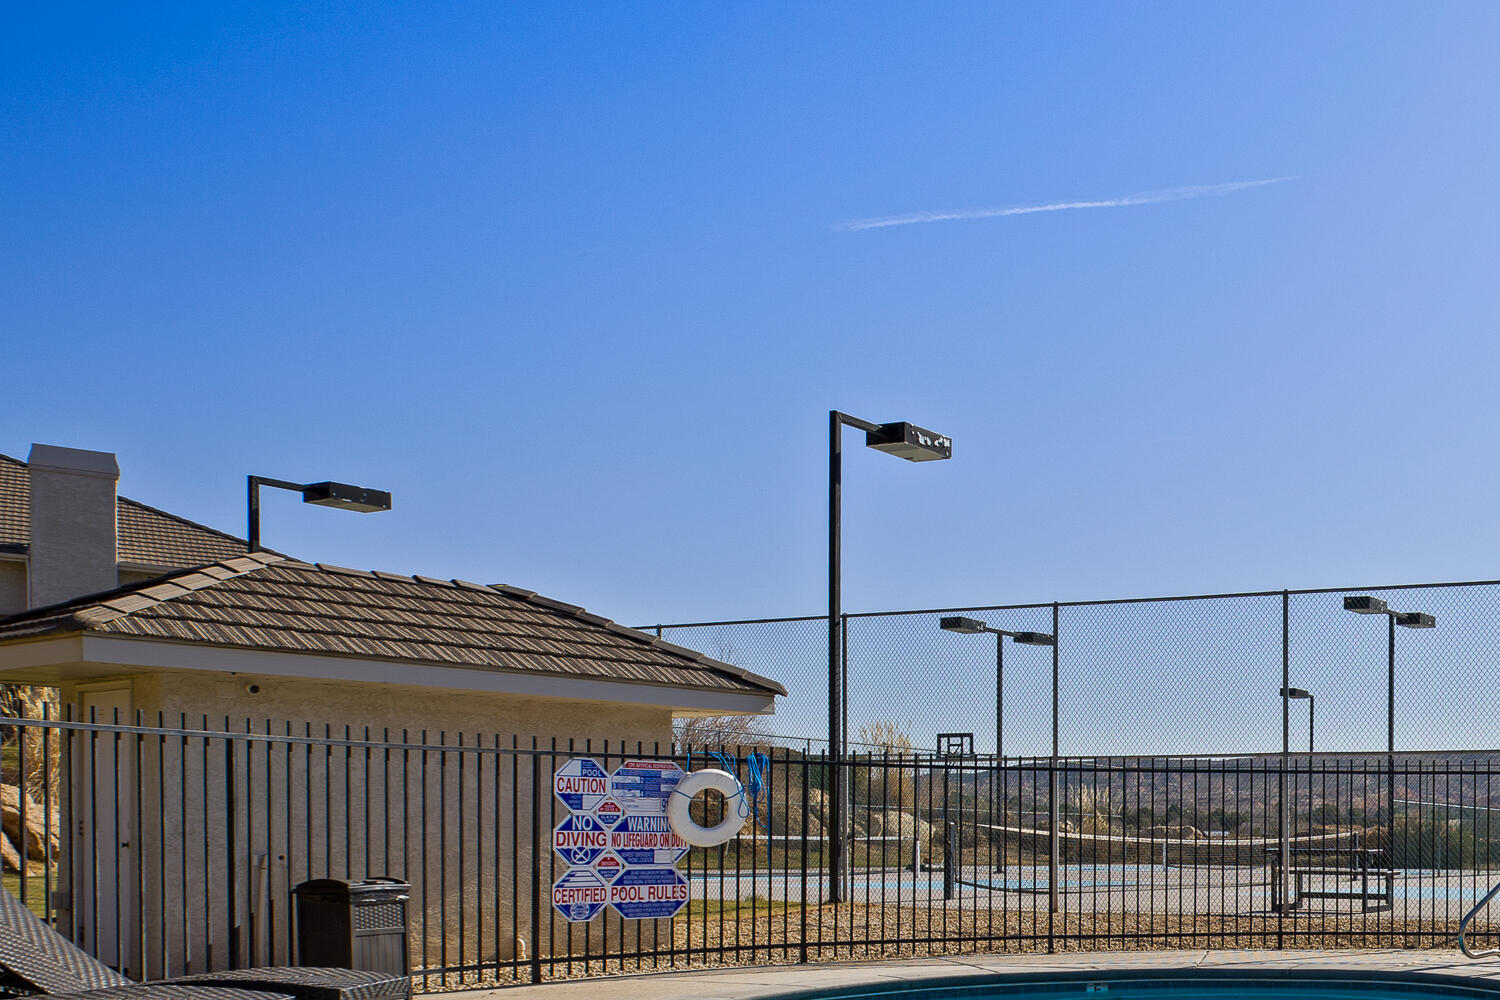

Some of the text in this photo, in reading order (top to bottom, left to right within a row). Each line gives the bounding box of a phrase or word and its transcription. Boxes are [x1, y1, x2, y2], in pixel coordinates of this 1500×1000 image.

[582, 769, 602, 777] POOL
[557, 777, 606, 793] CAUTION
[572, 817, 593, 831] NO
[556, 832, 607, 847] DIVING
[611, 833, 622, 847] NO
[623, 833, 658, 847] LIFEGUARD
[659, 833, 670, 847] ON
[554, 888, 607, 904] CERTIFIED
[611, 885, 688, 901] POOL RULES
